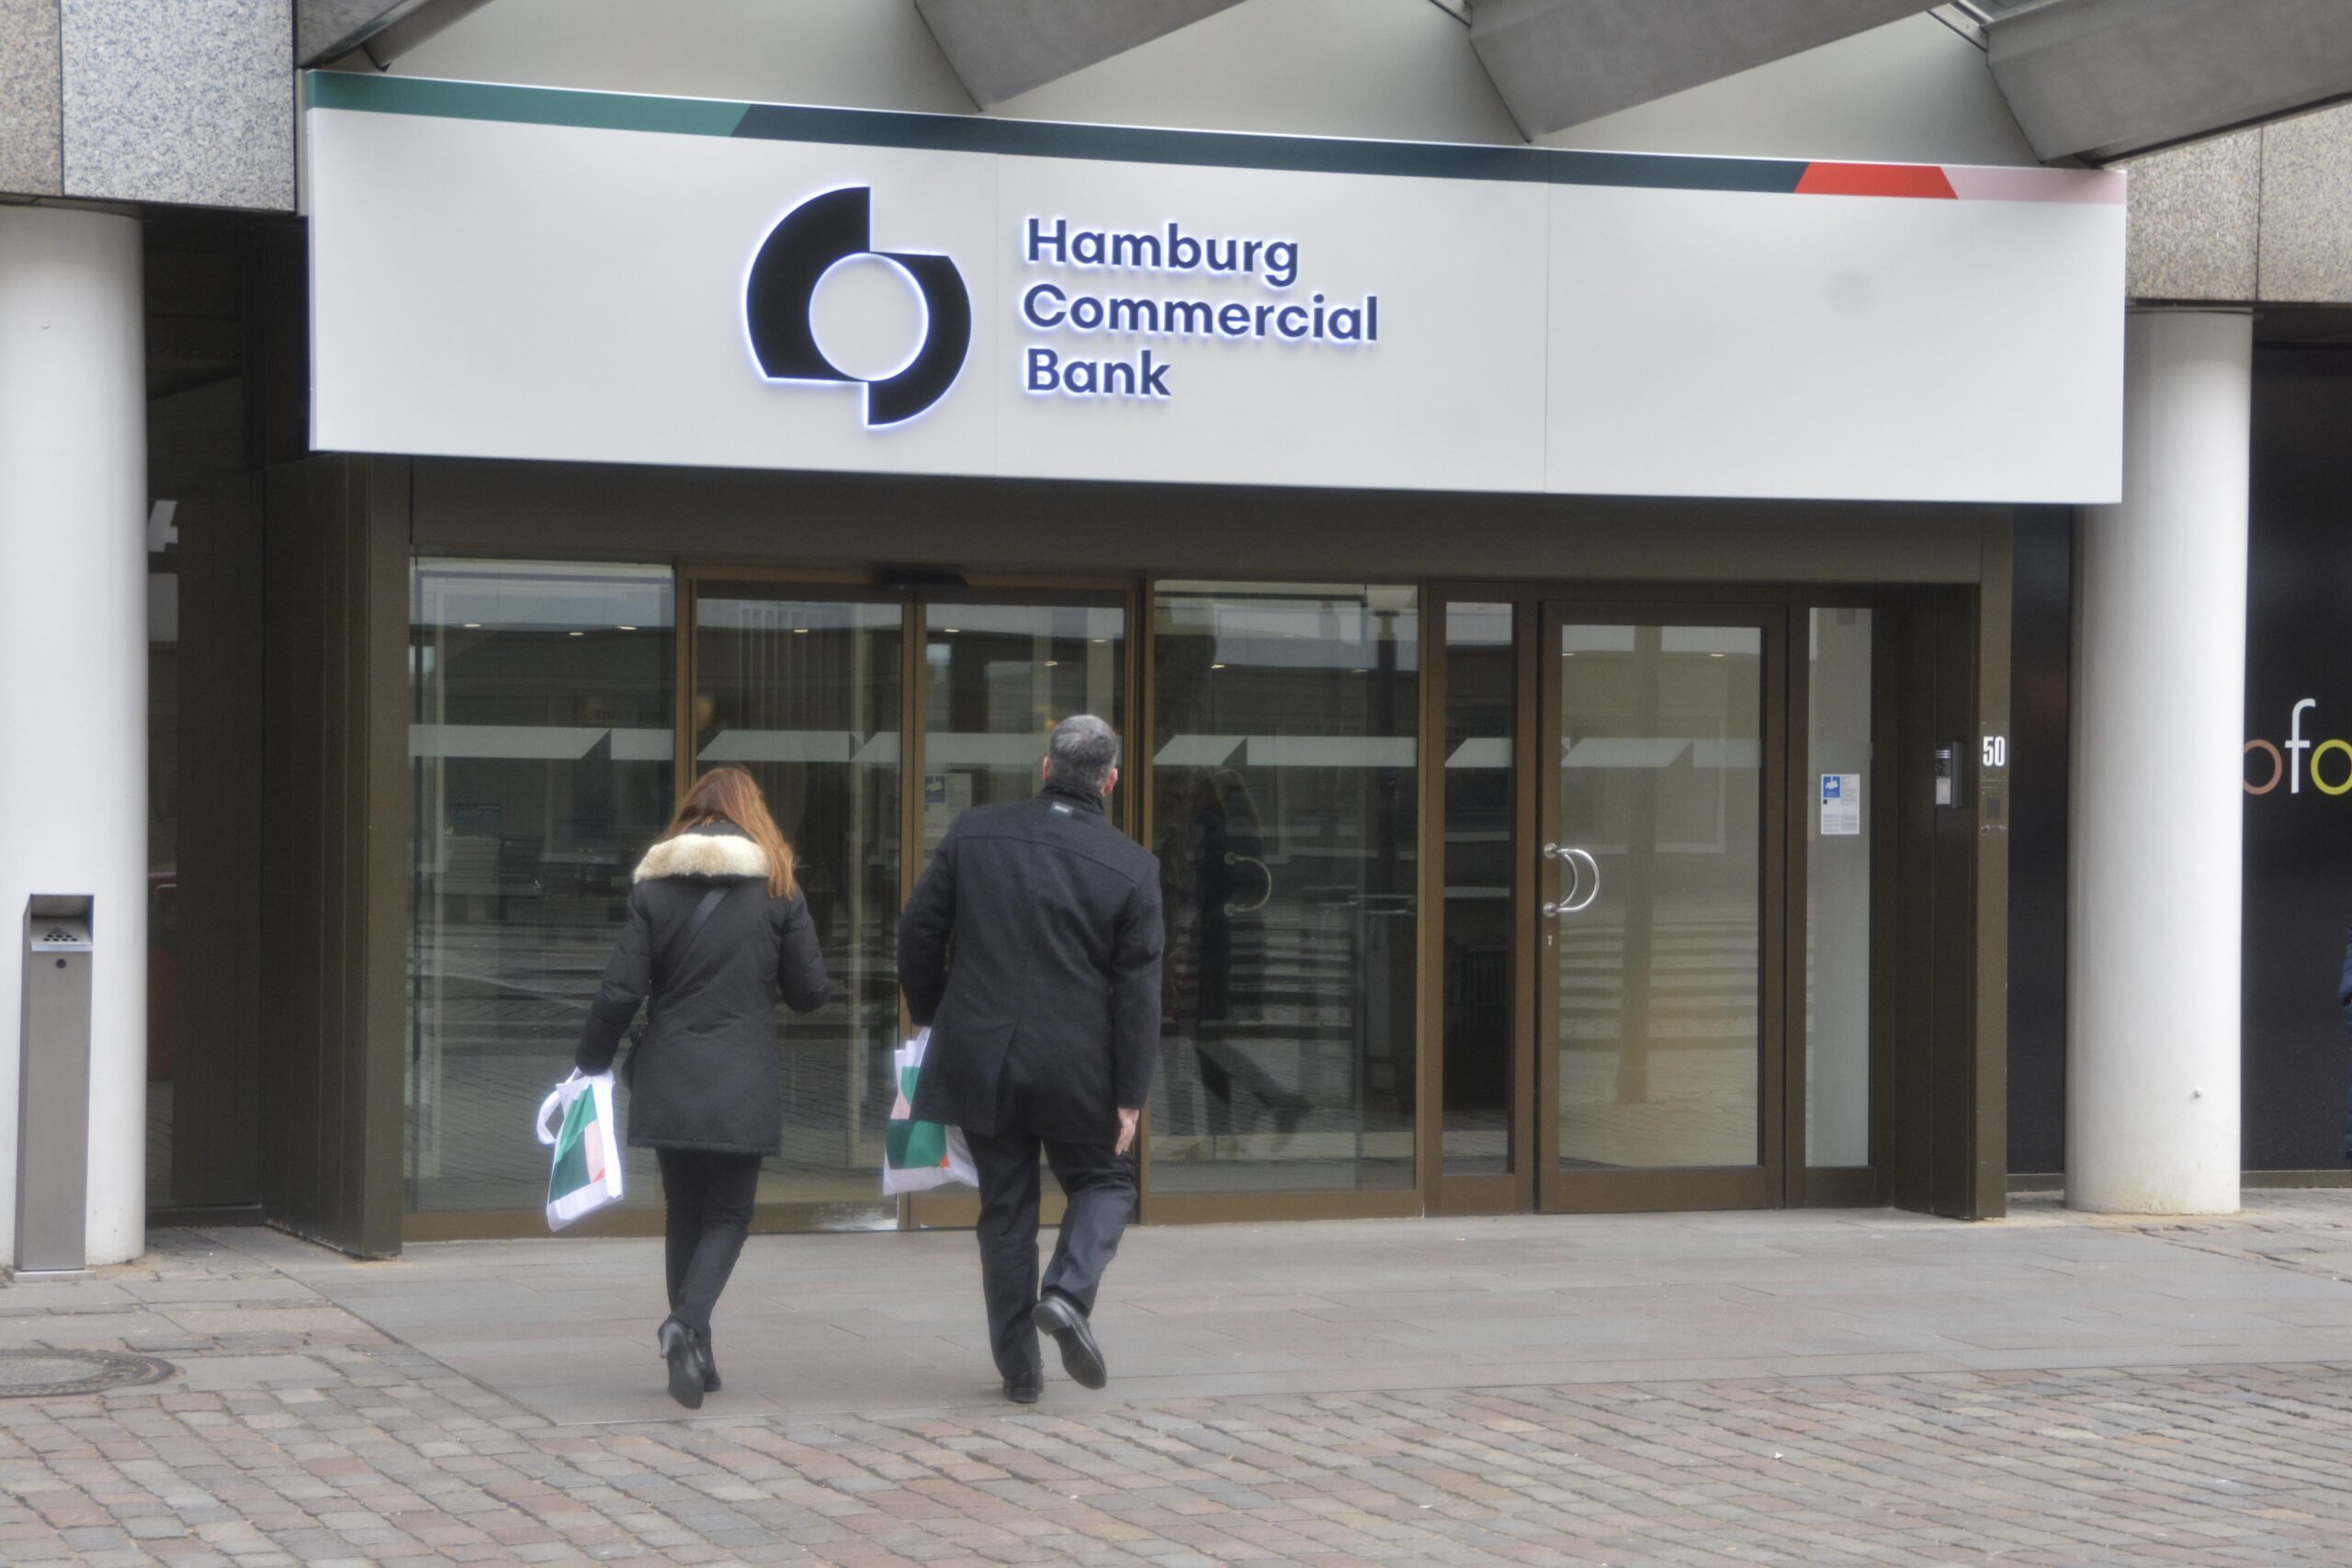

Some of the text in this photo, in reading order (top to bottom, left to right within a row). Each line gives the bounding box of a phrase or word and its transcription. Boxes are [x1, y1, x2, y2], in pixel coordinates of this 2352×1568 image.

[1027, 218, 1298, 288] Hamburg
[1023, 283, 1377, 341] Commercial
[1027, 348, 1171, 396] Bank
[1983, 736, 2006, 766] 50
